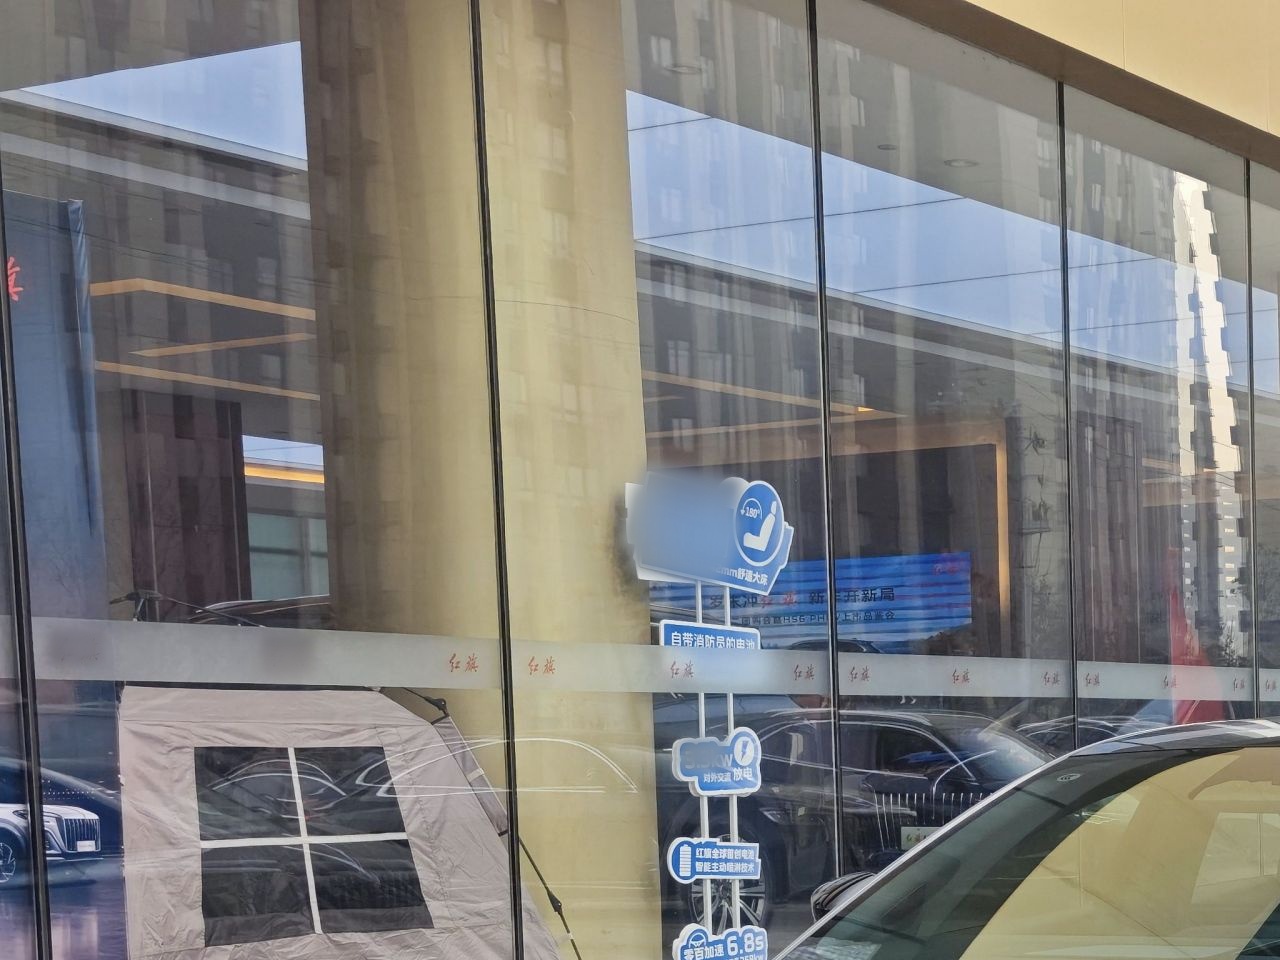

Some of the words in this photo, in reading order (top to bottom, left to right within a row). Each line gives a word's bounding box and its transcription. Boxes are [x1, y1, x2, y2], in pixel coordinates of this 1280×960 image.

[716, 567, 768, 586] mm舒适大床
[449, 653, 478, 672] 红旗
[528, 656, 556, 675] 红旗
[670, 660, 694, 678] 红旗
[794, 664, 815, 680] 红旗
[850, 666, 870, 682] 红旗
[733, 767, 754, 781] 放电
[726, 931, 764, 956] 6.8s
